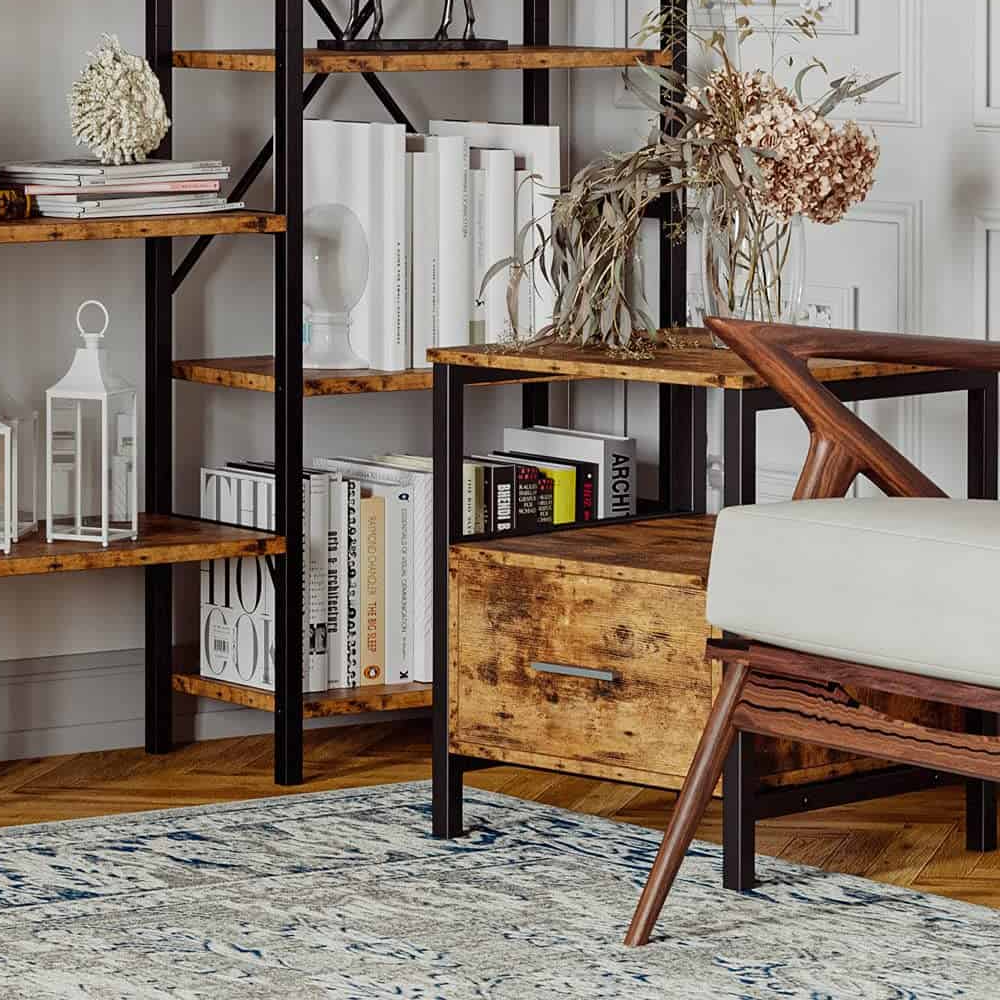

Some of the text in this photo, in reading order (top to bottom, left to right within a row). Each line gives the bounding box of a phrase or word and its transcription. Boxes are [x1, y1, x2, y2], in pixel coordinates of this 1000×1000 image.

[497, 484, 511, 520] BHENDI
[328, 531, 337, 551] arts
[328, 569, 339, 633] architecture
[368, 603, 376, 616] THE
[368, 618, 376, 630] BIG
[368, 632, 376, 652] SLEEP
